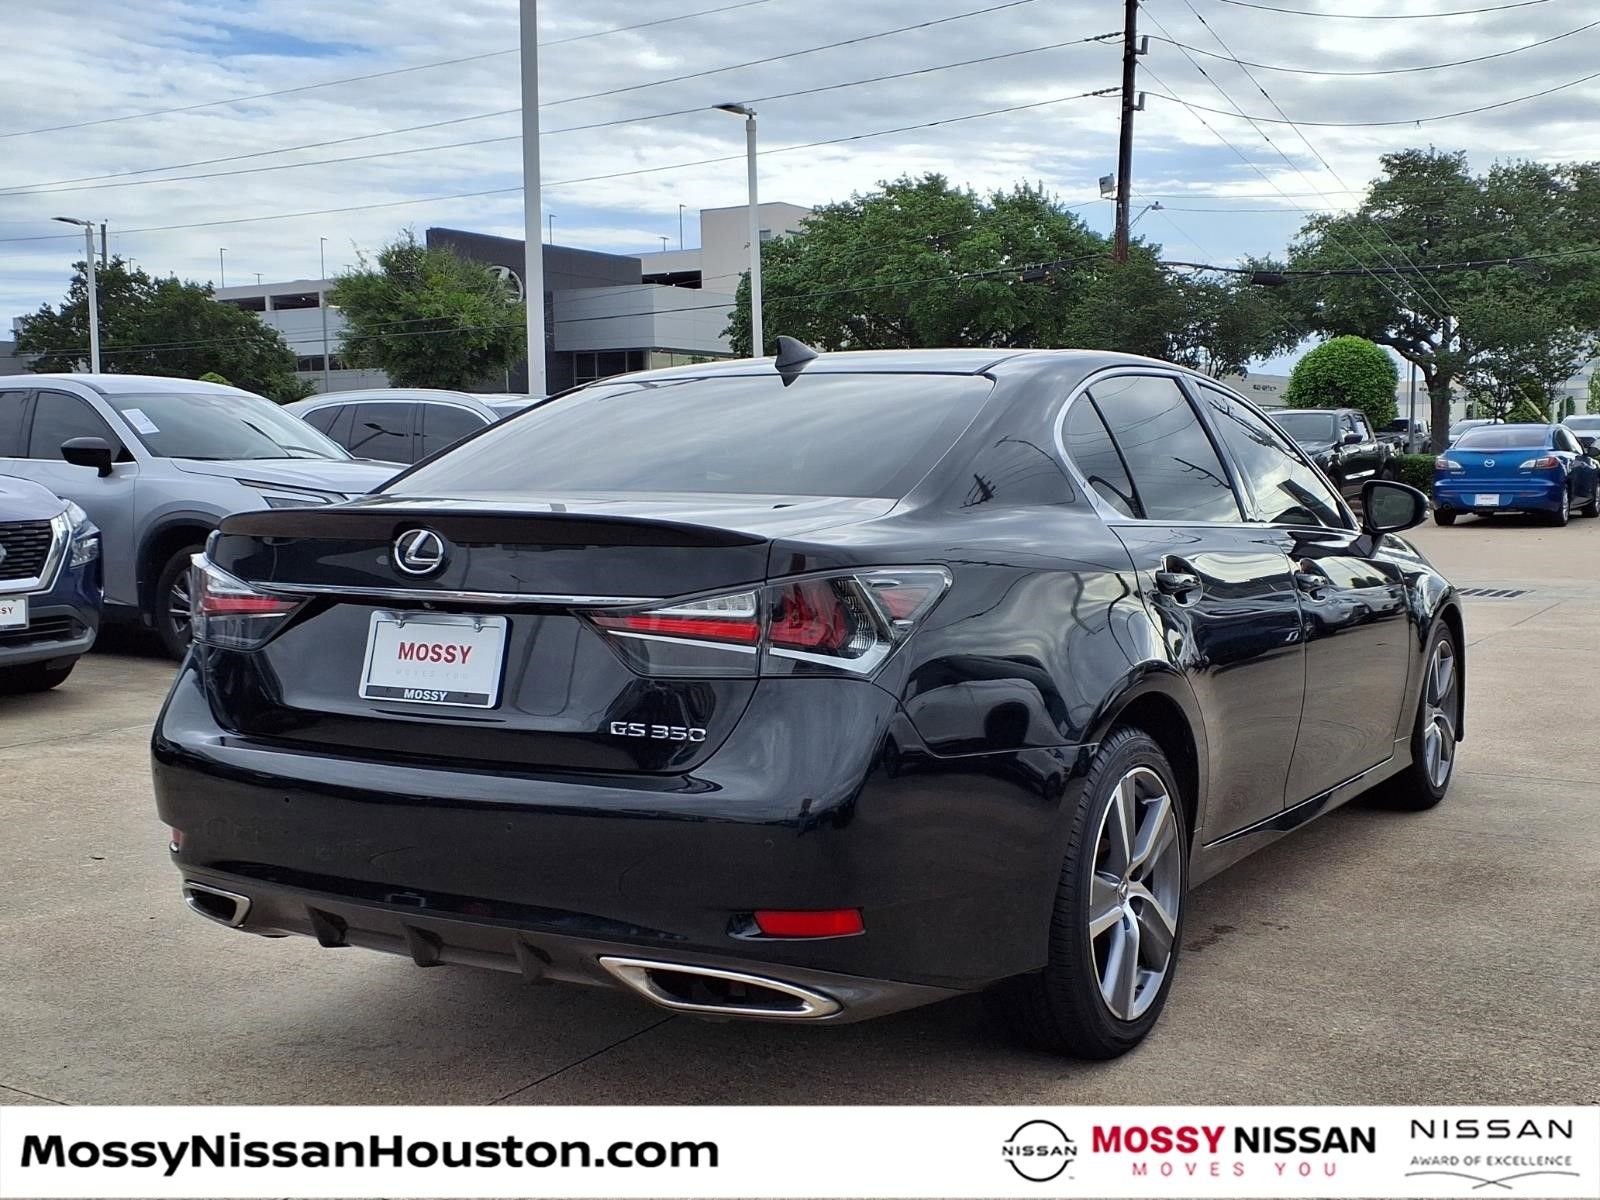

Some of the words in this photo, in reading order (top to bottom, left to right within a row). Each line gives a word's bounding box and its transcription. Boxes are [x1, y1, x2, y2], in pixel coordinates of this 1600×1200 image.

[398, 642, 472, 664] MOSSY
[404, 688, 448, 701] MOSSY
[610, 721, 646, 737] GS
[651, 724, 707, 742] 350
